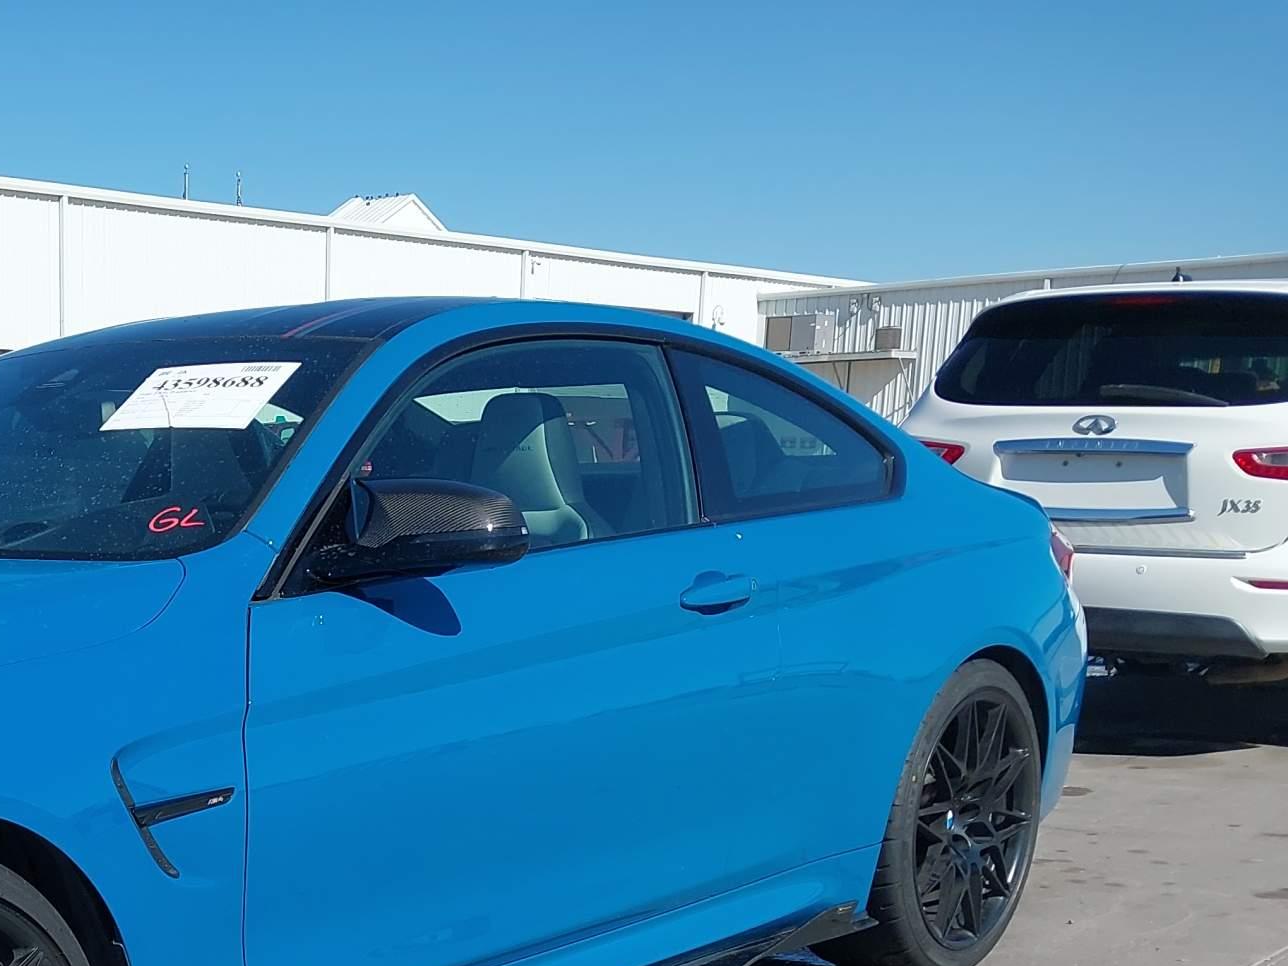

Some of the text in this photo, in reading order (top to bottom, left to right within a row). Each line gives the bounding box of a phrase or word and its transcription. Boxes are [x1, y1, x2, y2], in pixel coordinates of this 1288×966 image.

[153, 376, 269, 391] 43598688
[1217, 499, 1261, 516] JX35
[149, 506, 205, 532] GL
